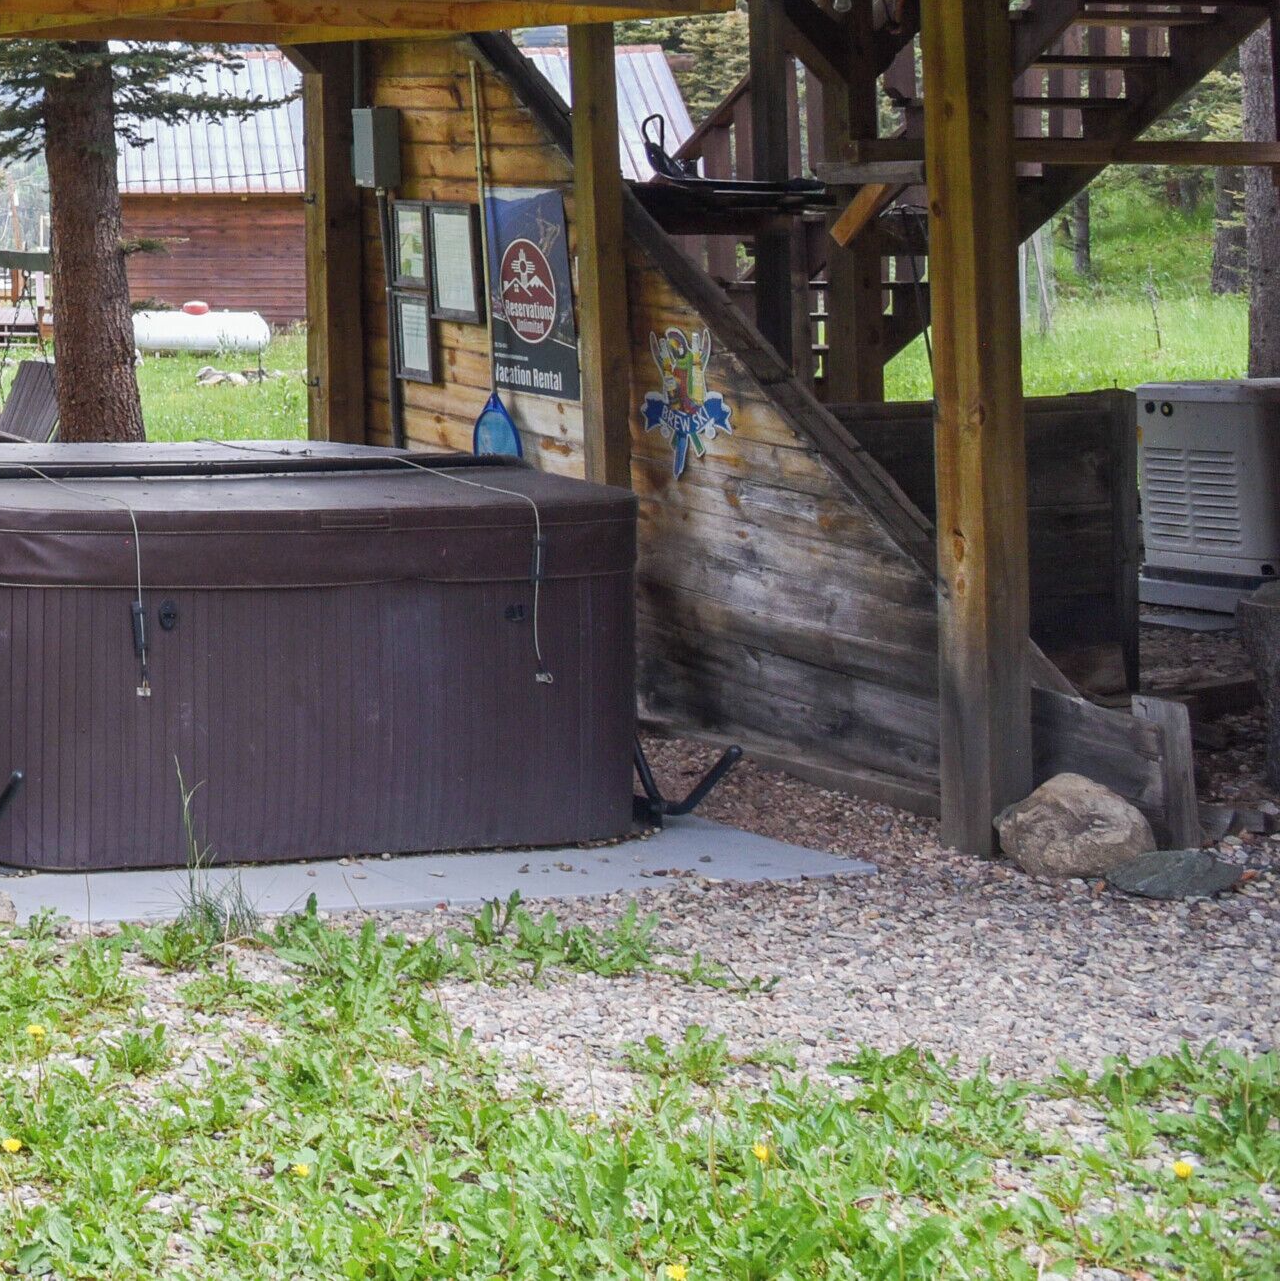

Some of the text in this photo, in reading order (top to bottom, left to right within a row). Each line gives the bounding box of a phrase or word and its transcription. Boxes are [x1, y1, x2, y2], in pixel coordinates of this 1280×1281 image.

[505, 299, 554, 320] Reservations
[517, 318, 544, 334] Unlimited
[533, 368, 562, 391] Rental
